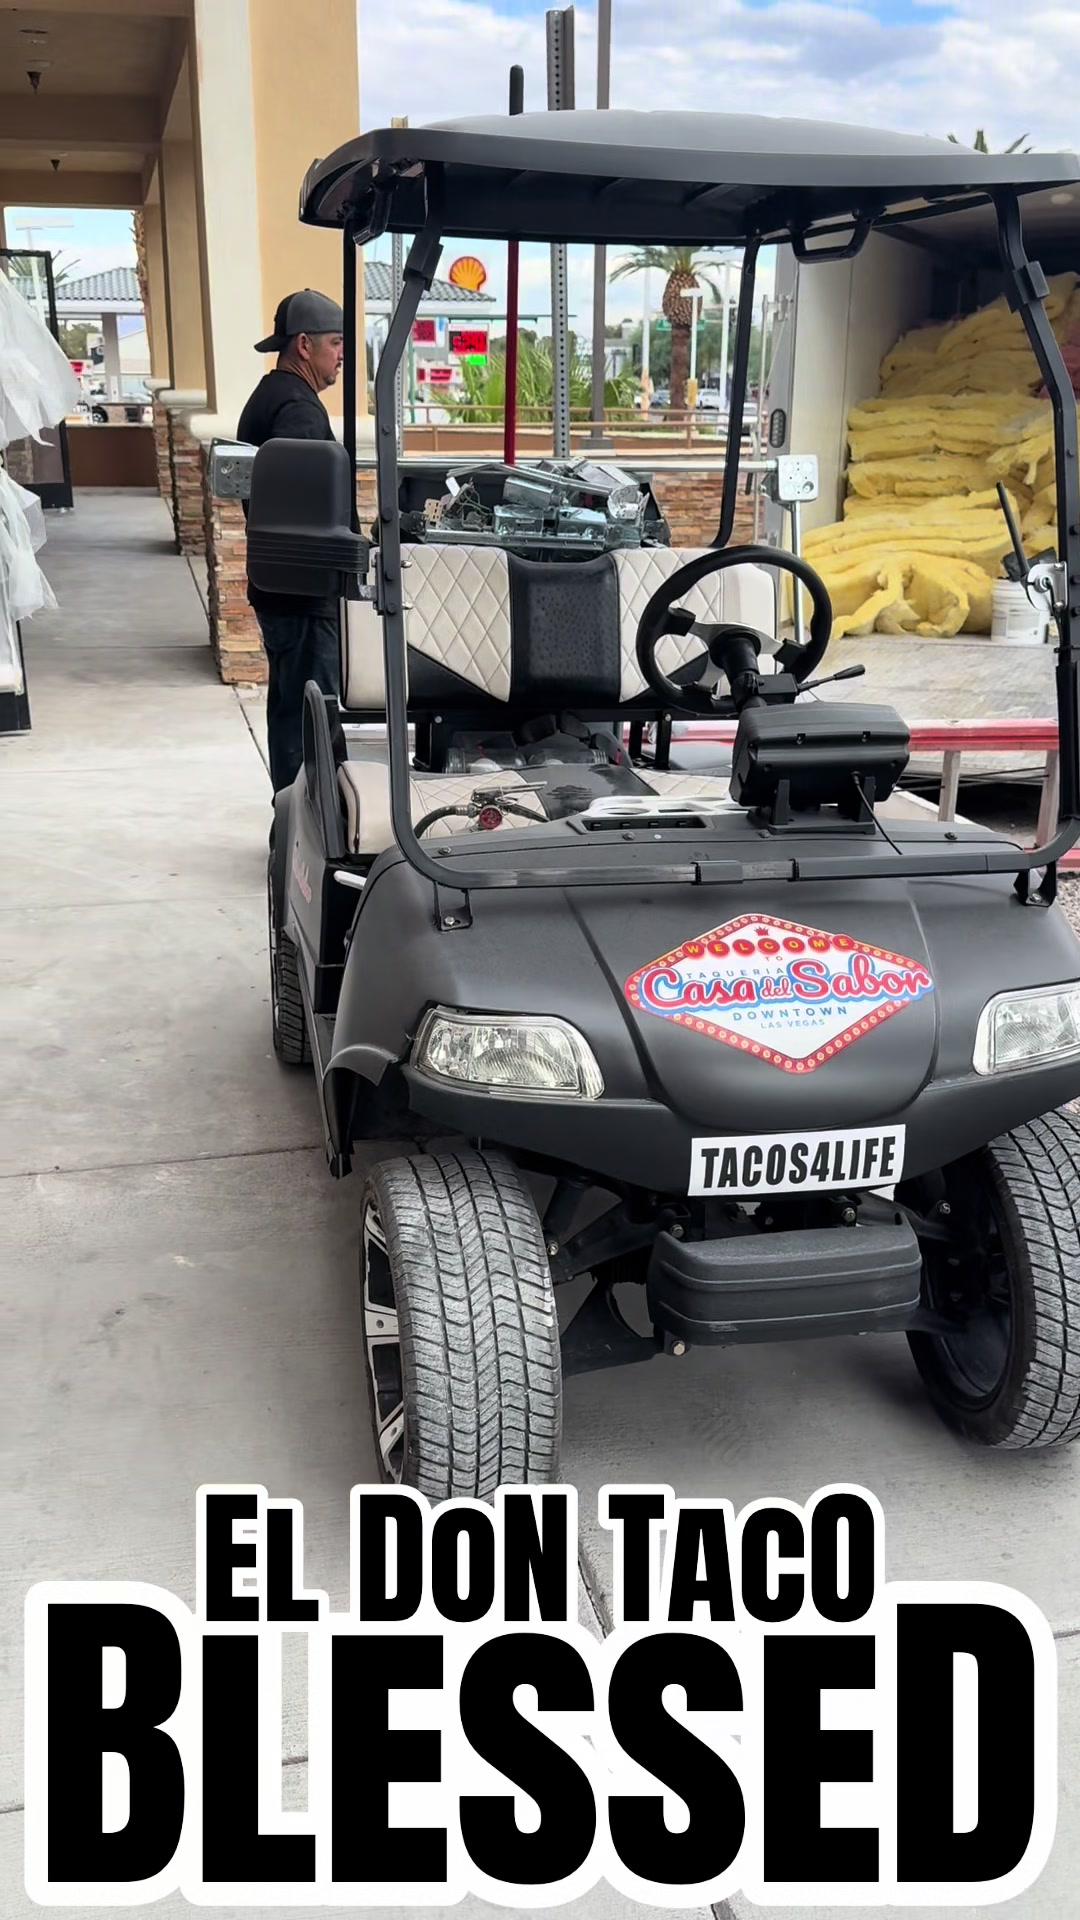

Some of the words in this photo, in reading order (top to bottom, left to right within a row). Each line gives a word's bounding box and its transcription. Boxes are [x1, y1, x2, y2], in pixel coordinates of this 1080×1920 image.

[685, 937, 849, 954] WELCOME
[764, 955, 784, 963] TO
[686, 967, 784, 979] TAQUERIA
[642, 967, 758, 1009] Casa
[761, 976, 792, 998] del
[791, 953, 931, 999] Sabor
[733, 1006, 847, 1021] DOWNTOWN
[760, 1020, 783, 1029] LAS
[787, 1018, 826, 1028] VEGAS
[702, 1137, 896, 1188] TACOS4LIFE
